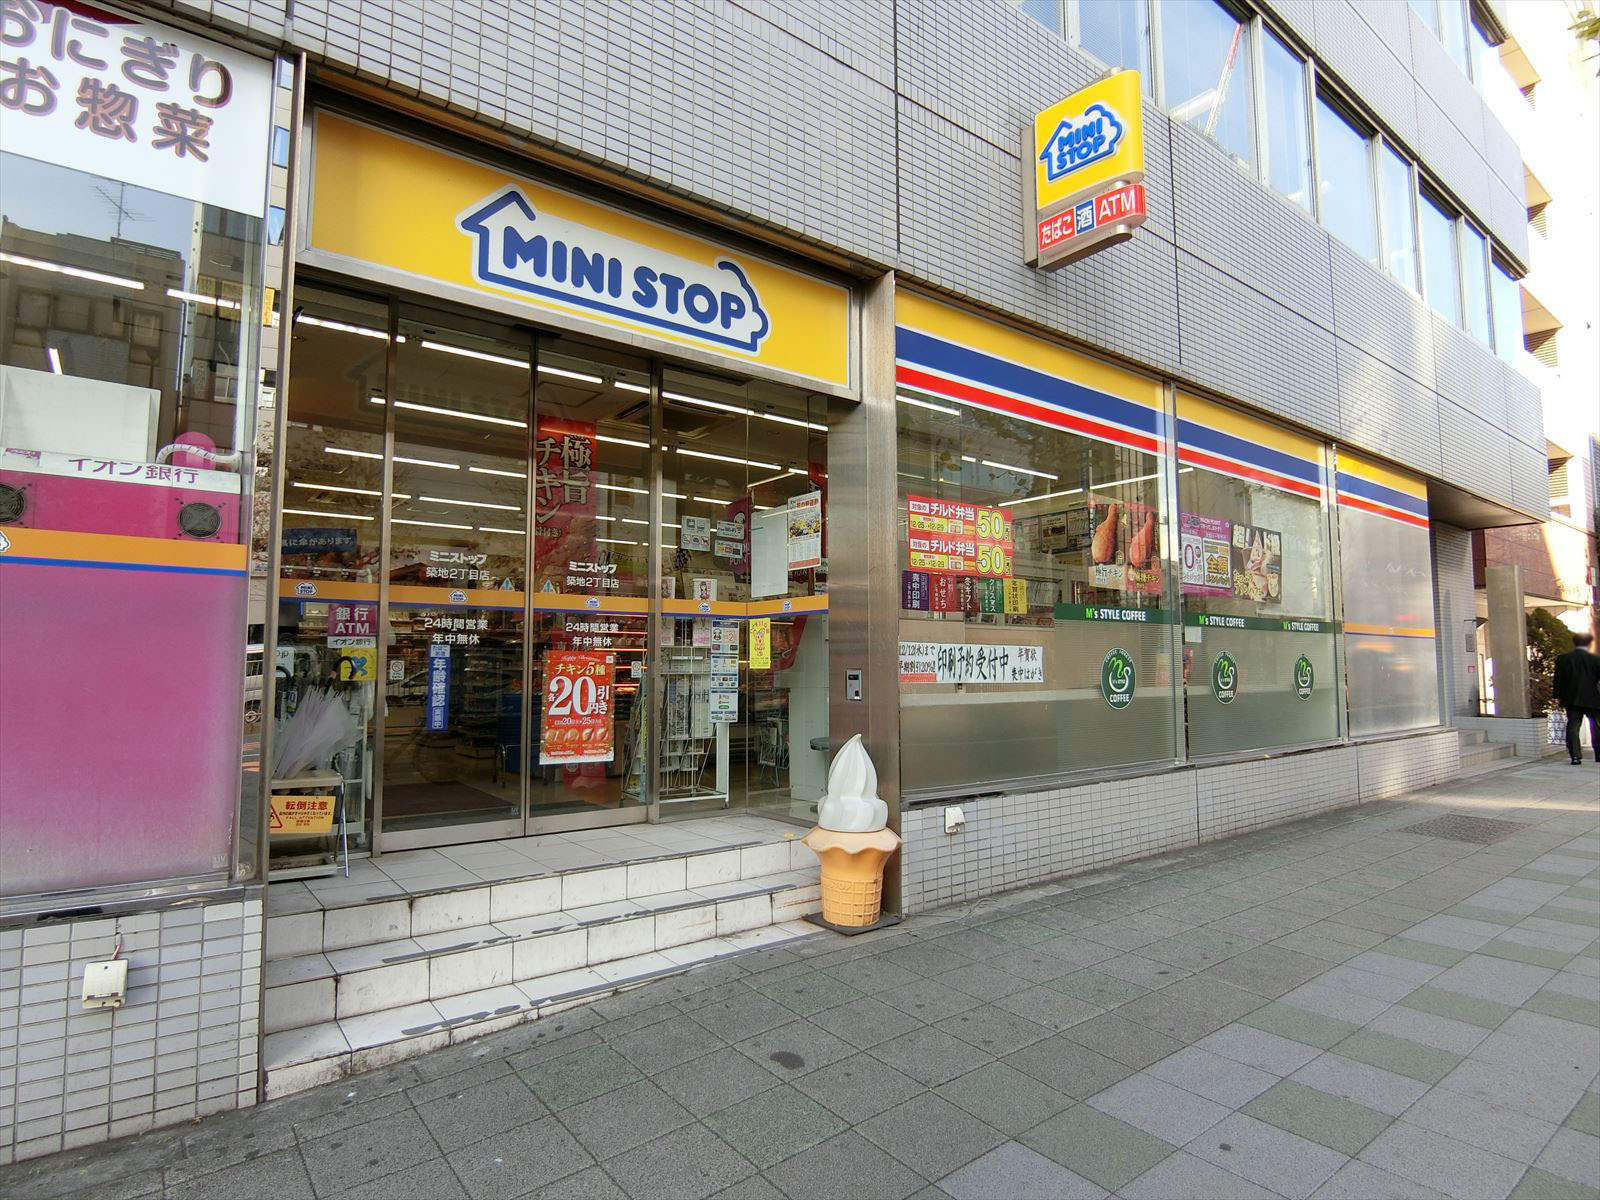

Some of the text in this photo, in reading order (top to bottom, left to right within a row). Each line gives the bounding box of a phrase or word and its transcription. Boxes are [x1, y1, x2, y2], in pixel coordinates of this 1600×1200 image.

[0, 56, 214, 162] お惣菜
[1058, 117, 1103, 153] MINI
[1056, 133, 1106, 171] STOP
[1099, 189, 1135, 221] ATM
[1076, 205, 1092, 230] 酒
[1041, 215, 1072, 247] たばこ
[502, 226, 745, 330] MINI STOP
[68, 457, 200, 484] イオン銀行
[560, 435, 593, 505] 極旨
[536, 437, 561, 524] チキン
[930, 503, 975, 521] チルド弁当
[976, 508, 1005, 541] 50
[930, 540, 975, 556] チルド弁当
[429, 550, 487, 564] ミニストップ
[976, 544, 1005, 576] 50
[426, 567, 490, 581] 築地2丁目店
[569, 561, 617, 574] ミニストップ
[566, 576, 620, 589] 築地2丁目店
[964, 577, 972, 610] 冬ギフト
[335, 607, 369, 621] 銀行
[1085, 607, 1146, 622] M's STYLE COFFEE
[1199, 615, 1245, 628] M's STYLE COFFEE
[335, 622, 370, 634] ATM
[424, 618, 489, 631] 24時間営業
[565, 622, 619, 633] 24時間営業
[1291, 622, 1303, 631] STYLE
[1304, 623, 1319, 632] COFFEE
[332, 638, 372, 646] イオン銀行
[432, 633, 481, 645] 年中無休
[572, 636, 613, 647] 年中無休
[1017, 647, 1038, 662] 年賀状
[555, 662, 607, 676] チキン5種
[937, 646, 1009, 681] 印刷予約受付中
[1011, 666, 1043, 682] 喪中はがき
[432, 658, 447, 707] 年齢確認
[548, 675, 597, 716] 20
[1109, 694, 1130, 703] COFFEE
[285, 800, 328, 810] 転倒注意
